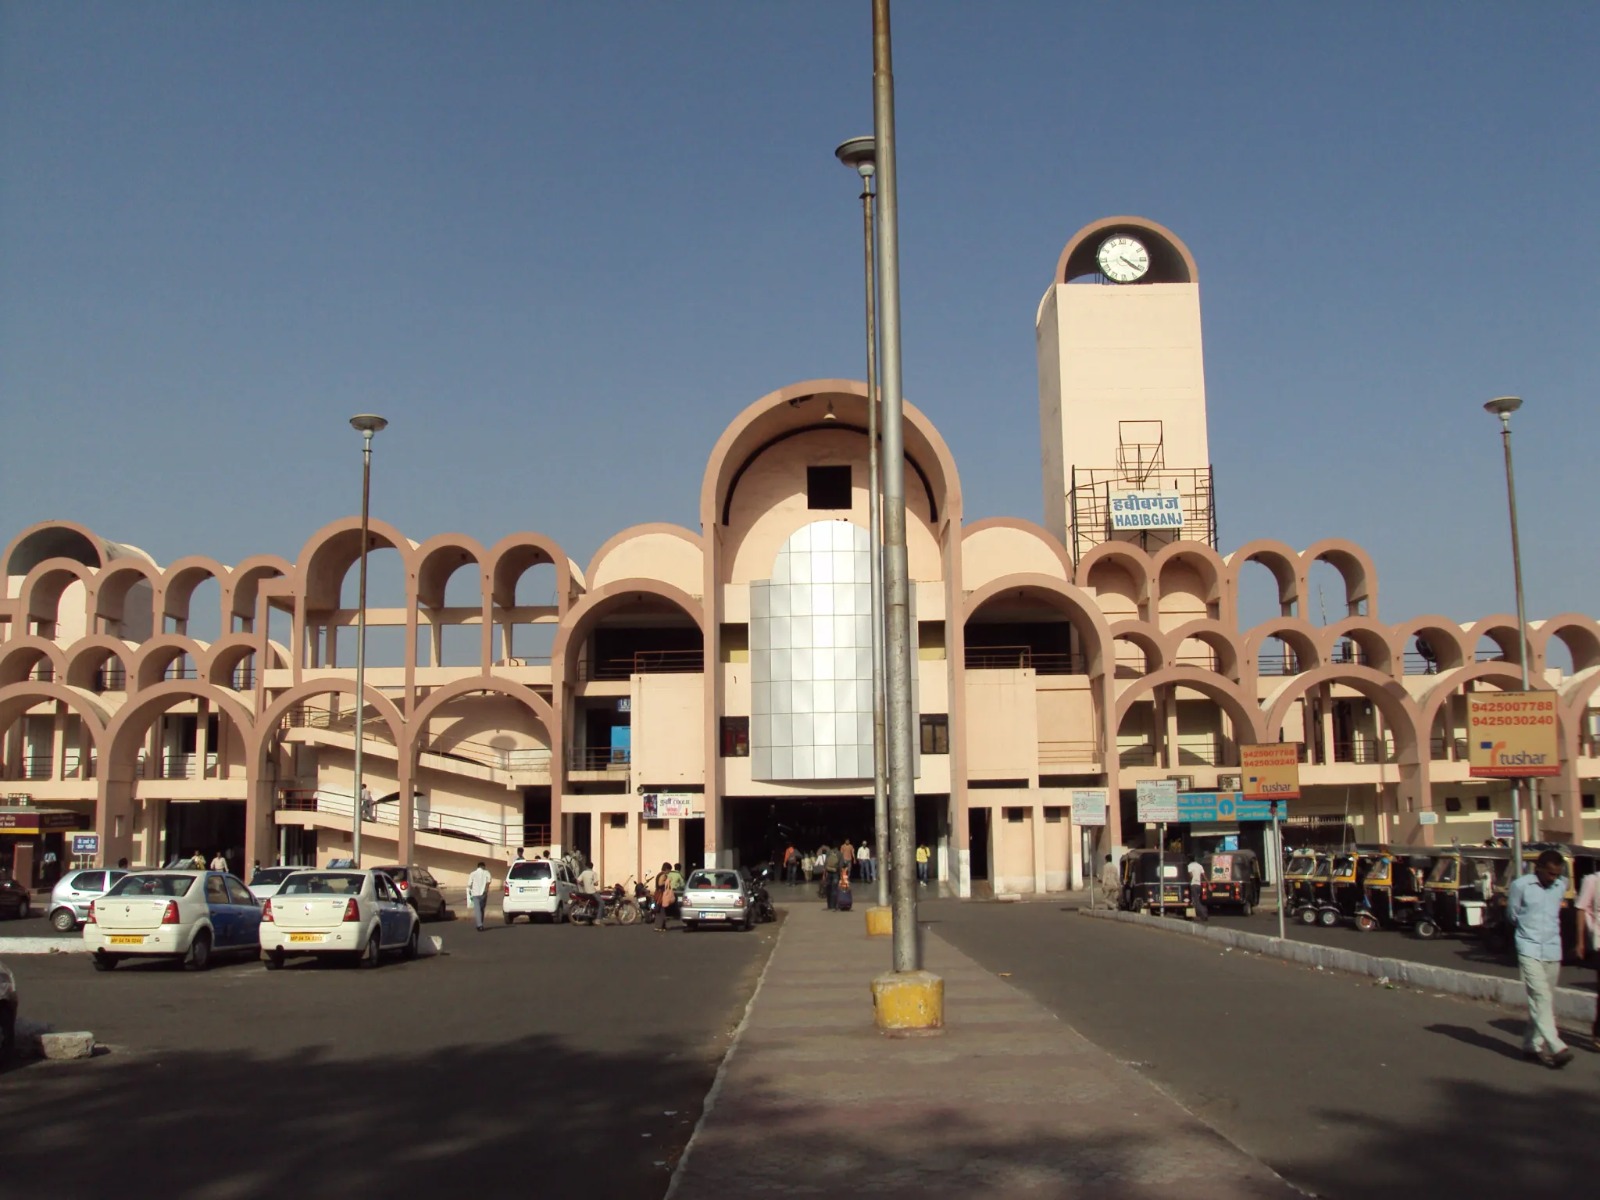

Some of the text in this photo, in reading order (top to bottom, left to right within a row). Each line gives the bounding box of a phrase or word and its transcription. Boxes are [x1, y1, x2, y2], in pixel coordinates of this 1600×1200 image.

[1113, 493, 1179, 511] हबीबगंज
[1115, 513, 1182, 527] HABIBGANJ
[1472, 701, 1553, 712] 9425007788
[1472, 716, 1553, 726] 9425030240
[1500, 750, 1547, 765] tushar
[1262, 782, 1292, 793] tushar
